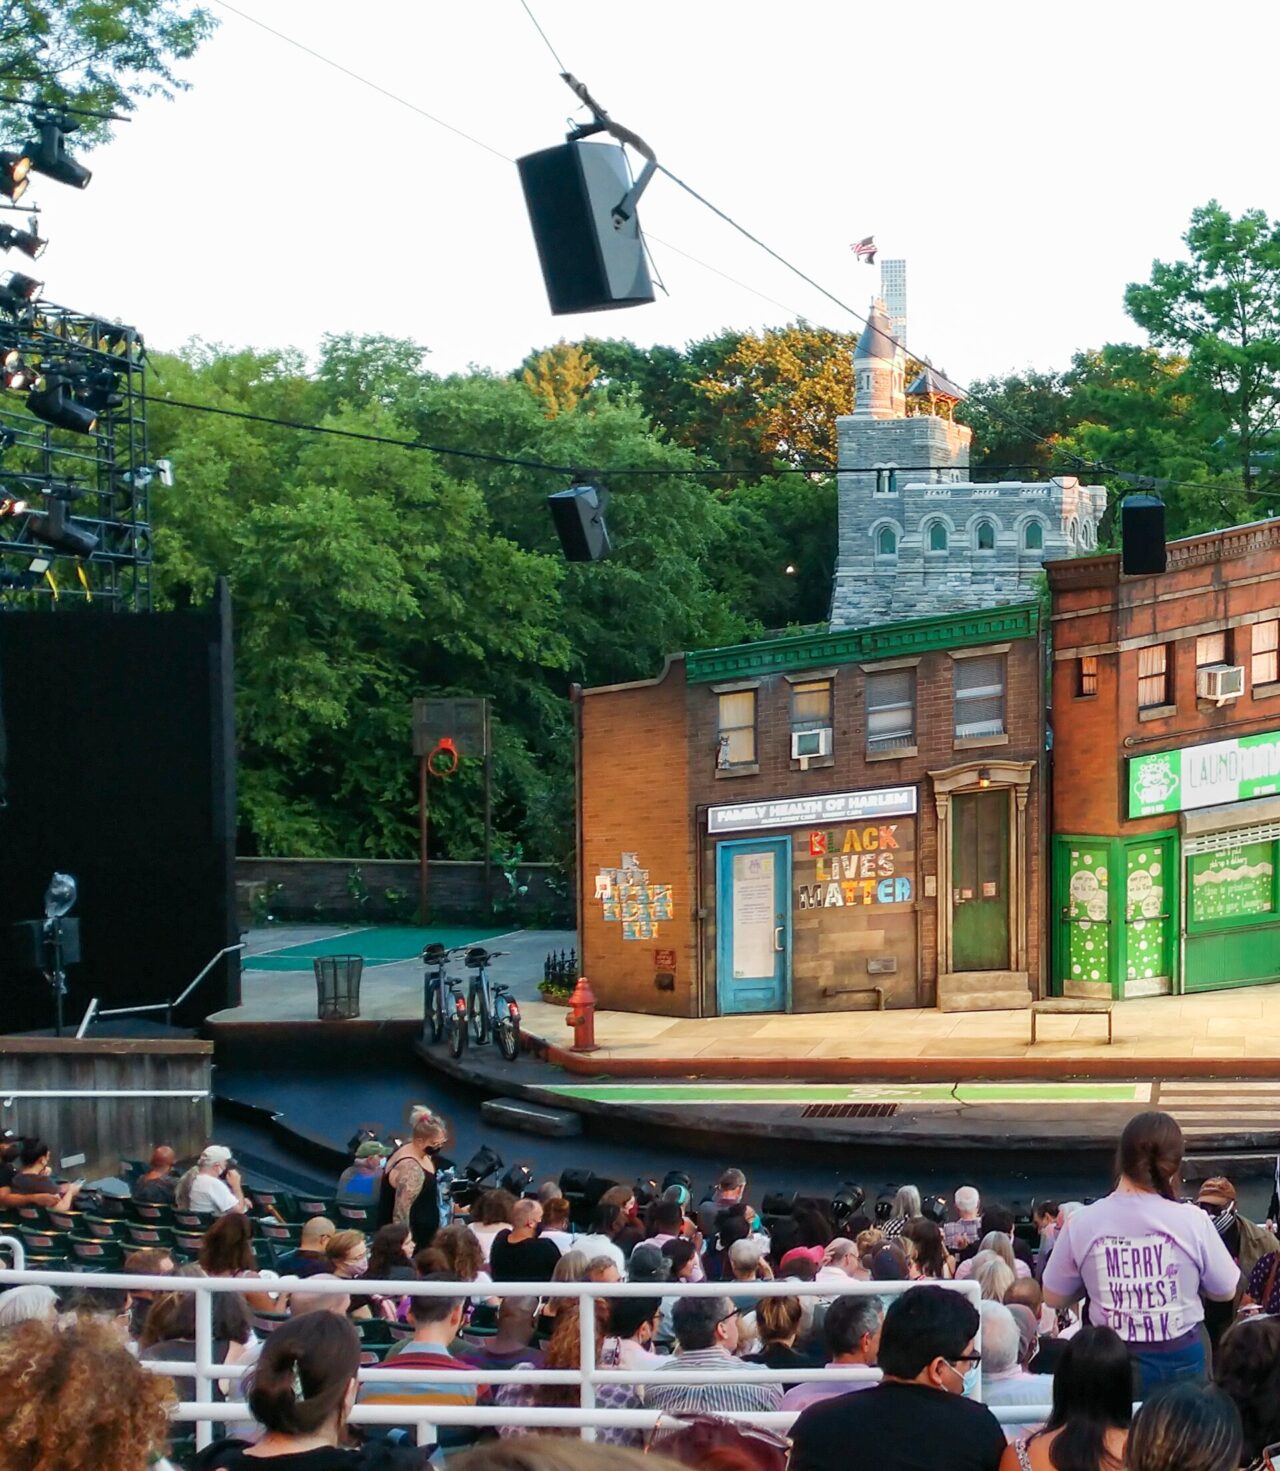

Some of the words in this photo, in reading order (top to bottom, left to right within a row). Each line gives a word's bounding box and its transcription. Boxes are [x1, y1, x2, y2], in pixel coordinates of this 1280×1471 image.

[717, 806, 768, 823] FAMILY
[769, 801, 823, 818] HEALTH
[825, 798, 846, 811] OF
[848, 791, 908, 810] HARLEM
[808, 824, 900, 857] BLACK
[815, 851, 895, 881] LIVES
[799, 877, 912, 911] MATTER
[1105, 1243, 1163, 1279] MERRY
[1109, 1280, 1168, 1310] WIVES
